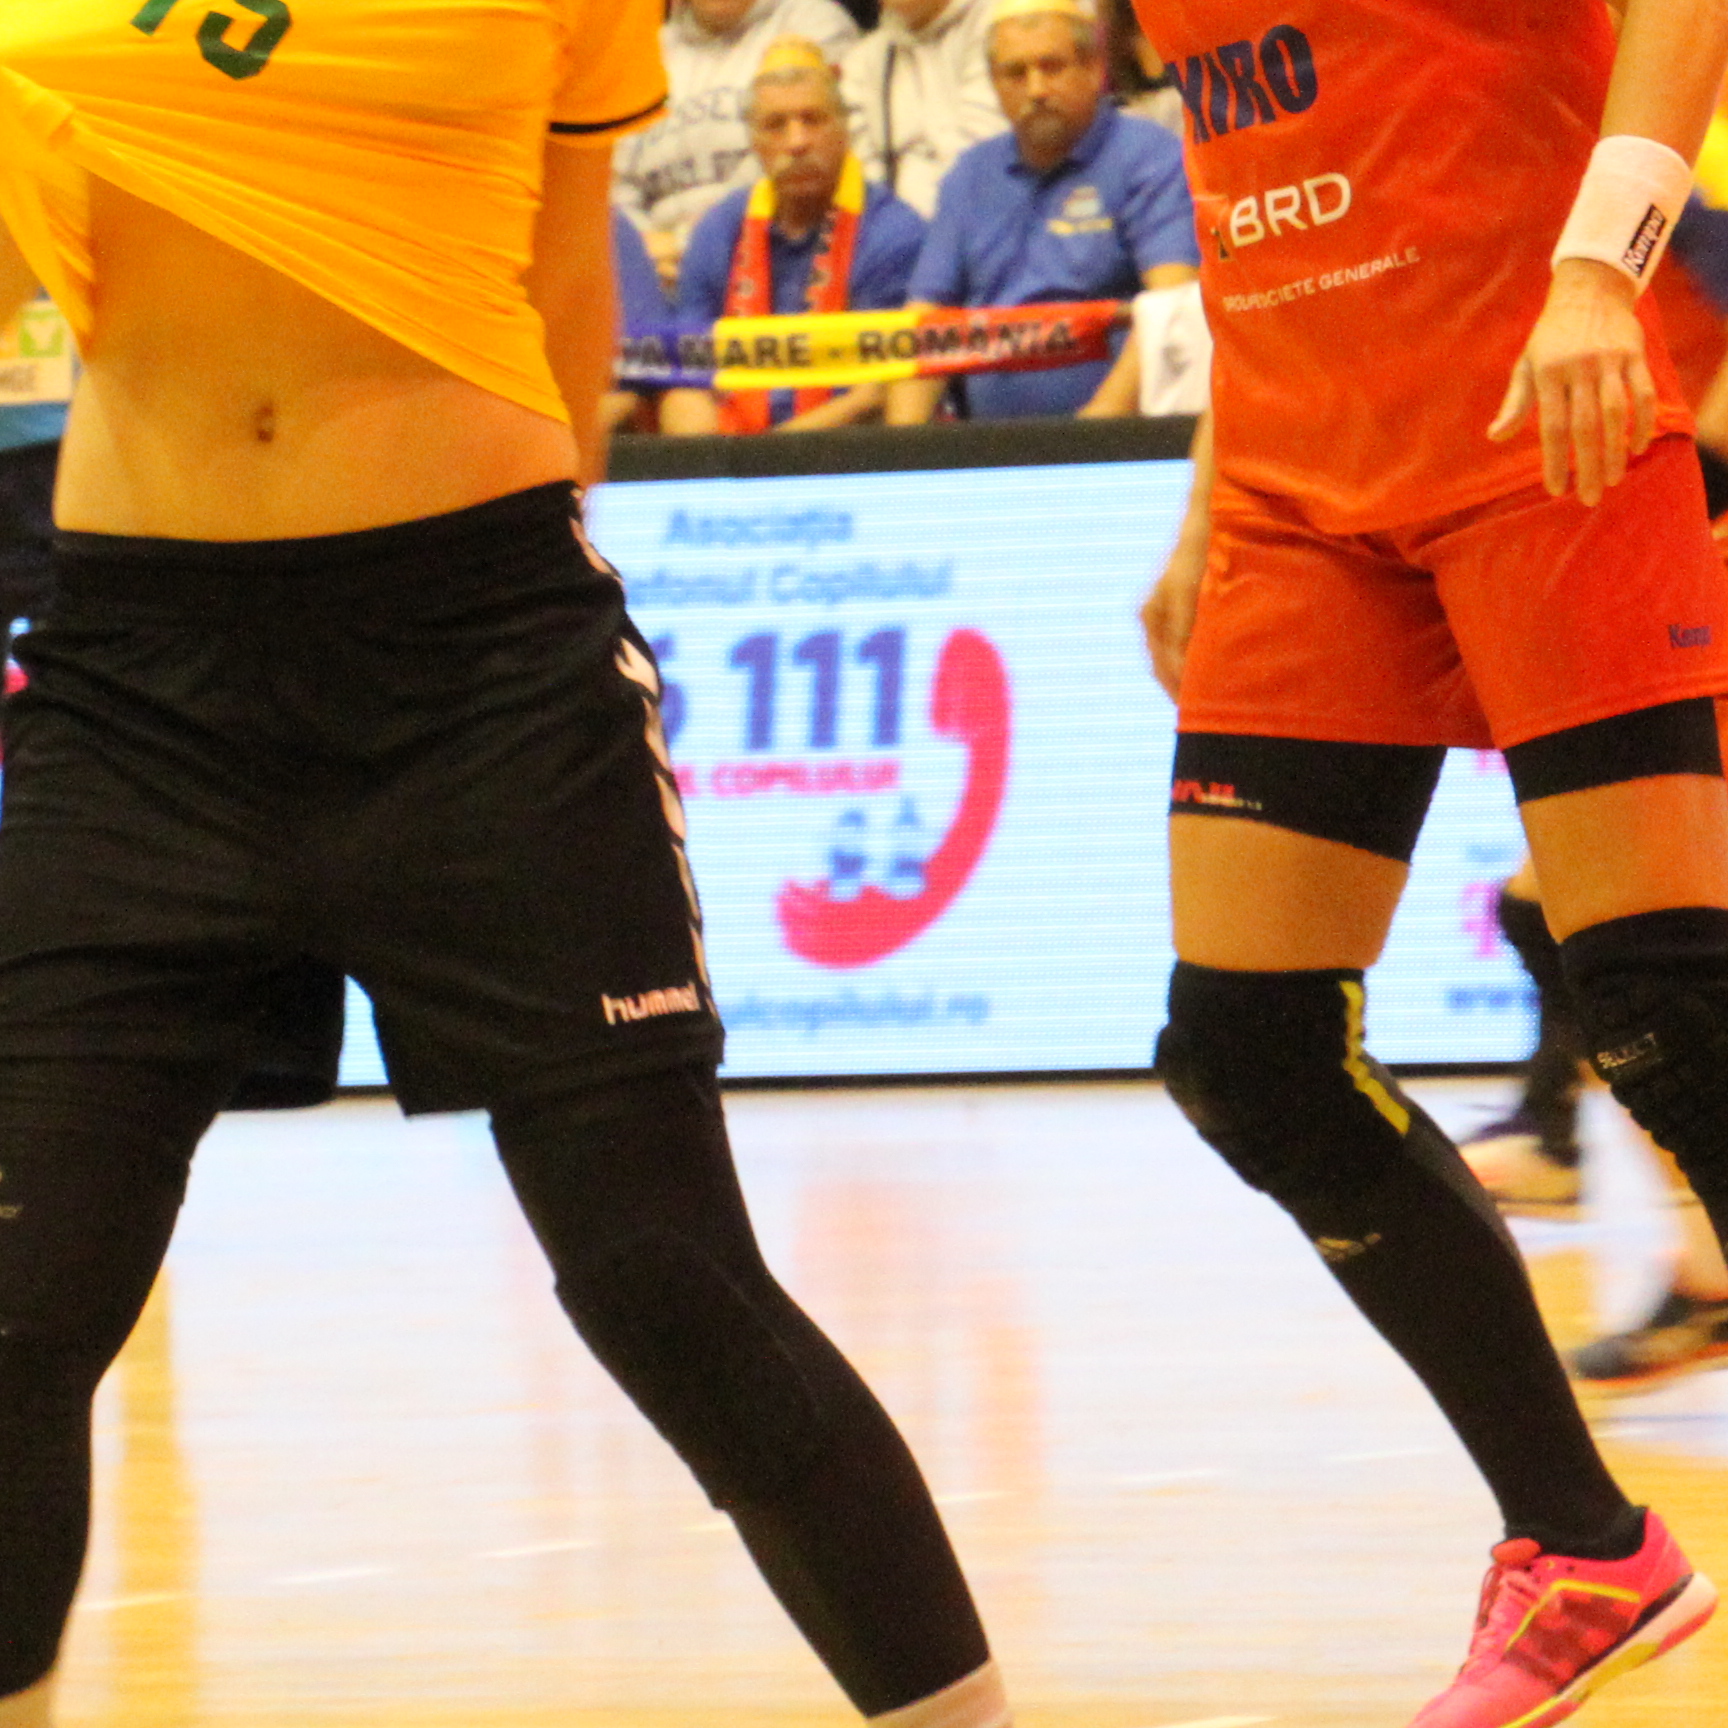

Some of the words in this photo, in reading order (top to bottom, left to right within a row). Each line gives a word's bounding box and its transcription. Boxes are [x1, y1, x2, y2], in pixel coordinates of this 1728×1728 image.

[1164, 23, 1319, 145] NIRO
[1229, 172, 1353, 249] BRD
[1318, 245, 1422, 291] GENERALE
[730, 627, 906, 750] 111
[600, 980, 702, 1026] hummel
